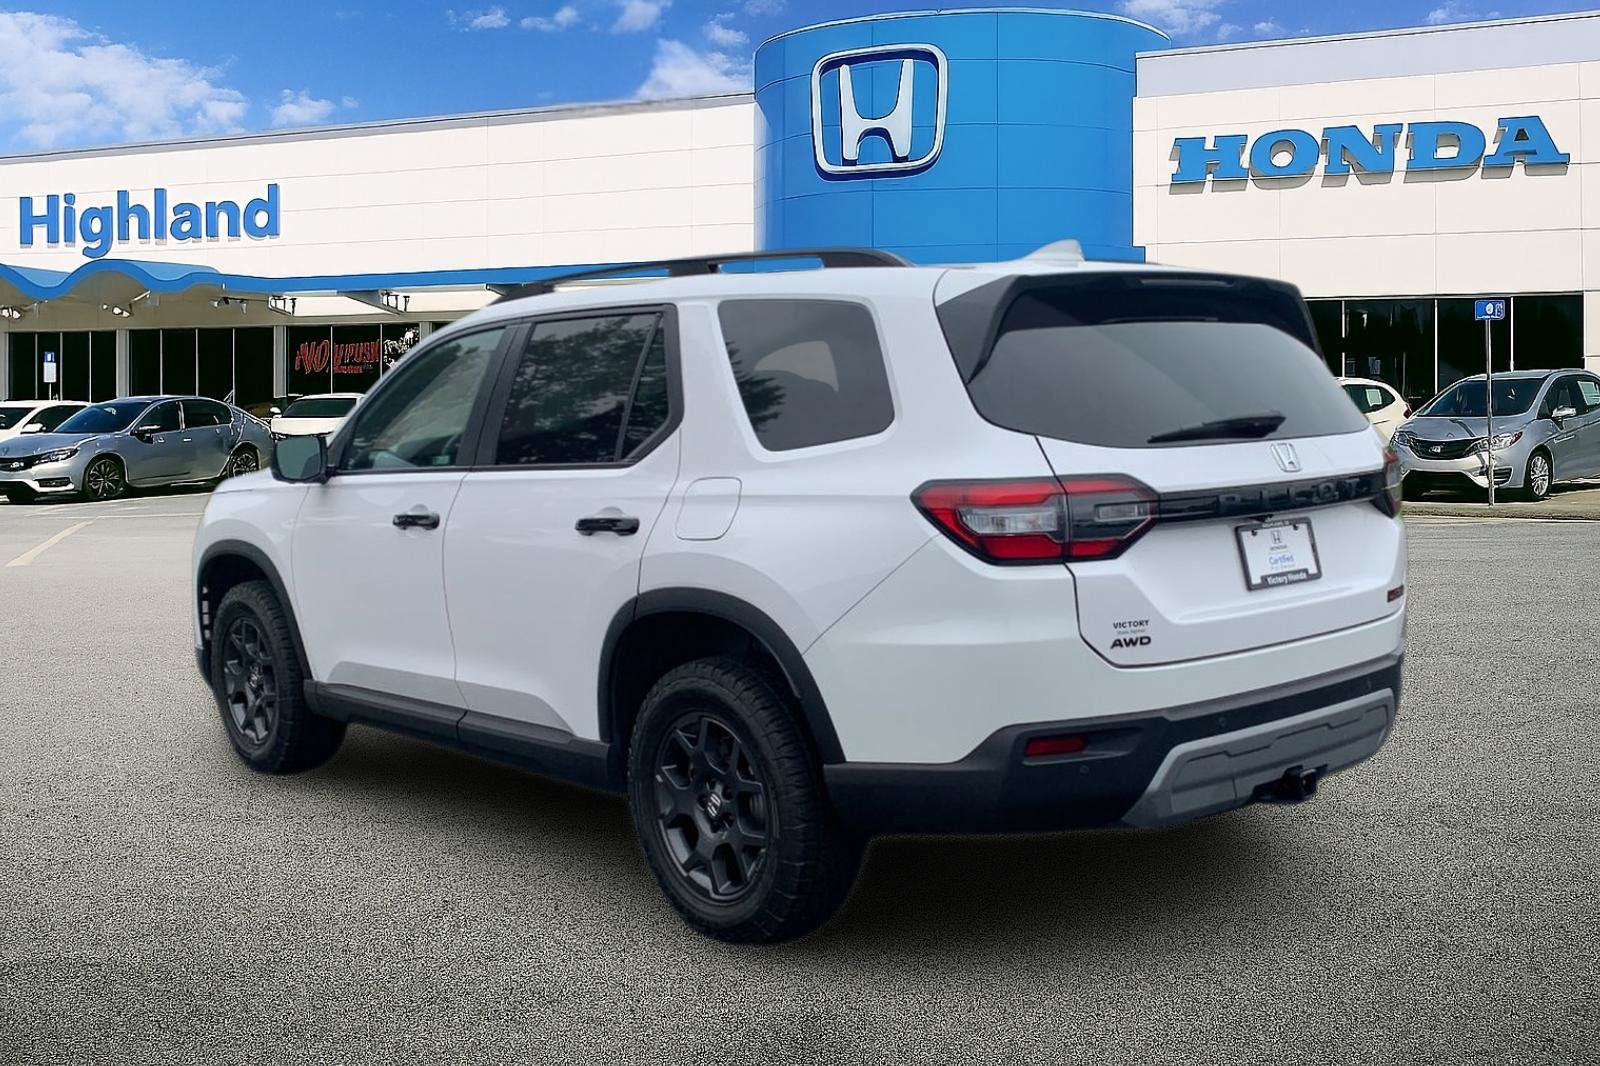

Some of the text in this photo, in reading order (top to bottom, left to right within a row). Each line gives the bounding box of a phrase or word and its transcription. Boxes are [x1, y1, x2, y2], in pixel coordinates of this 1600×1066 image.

[1170, 115, 1571, 188] HONDA
[19, 183, 281, 258] Highland
[1267, 575, 1288, 585] Victory
[1112, 619, 1149, 630] VICTORY
[1110, 635, 1152, 650] AWD
